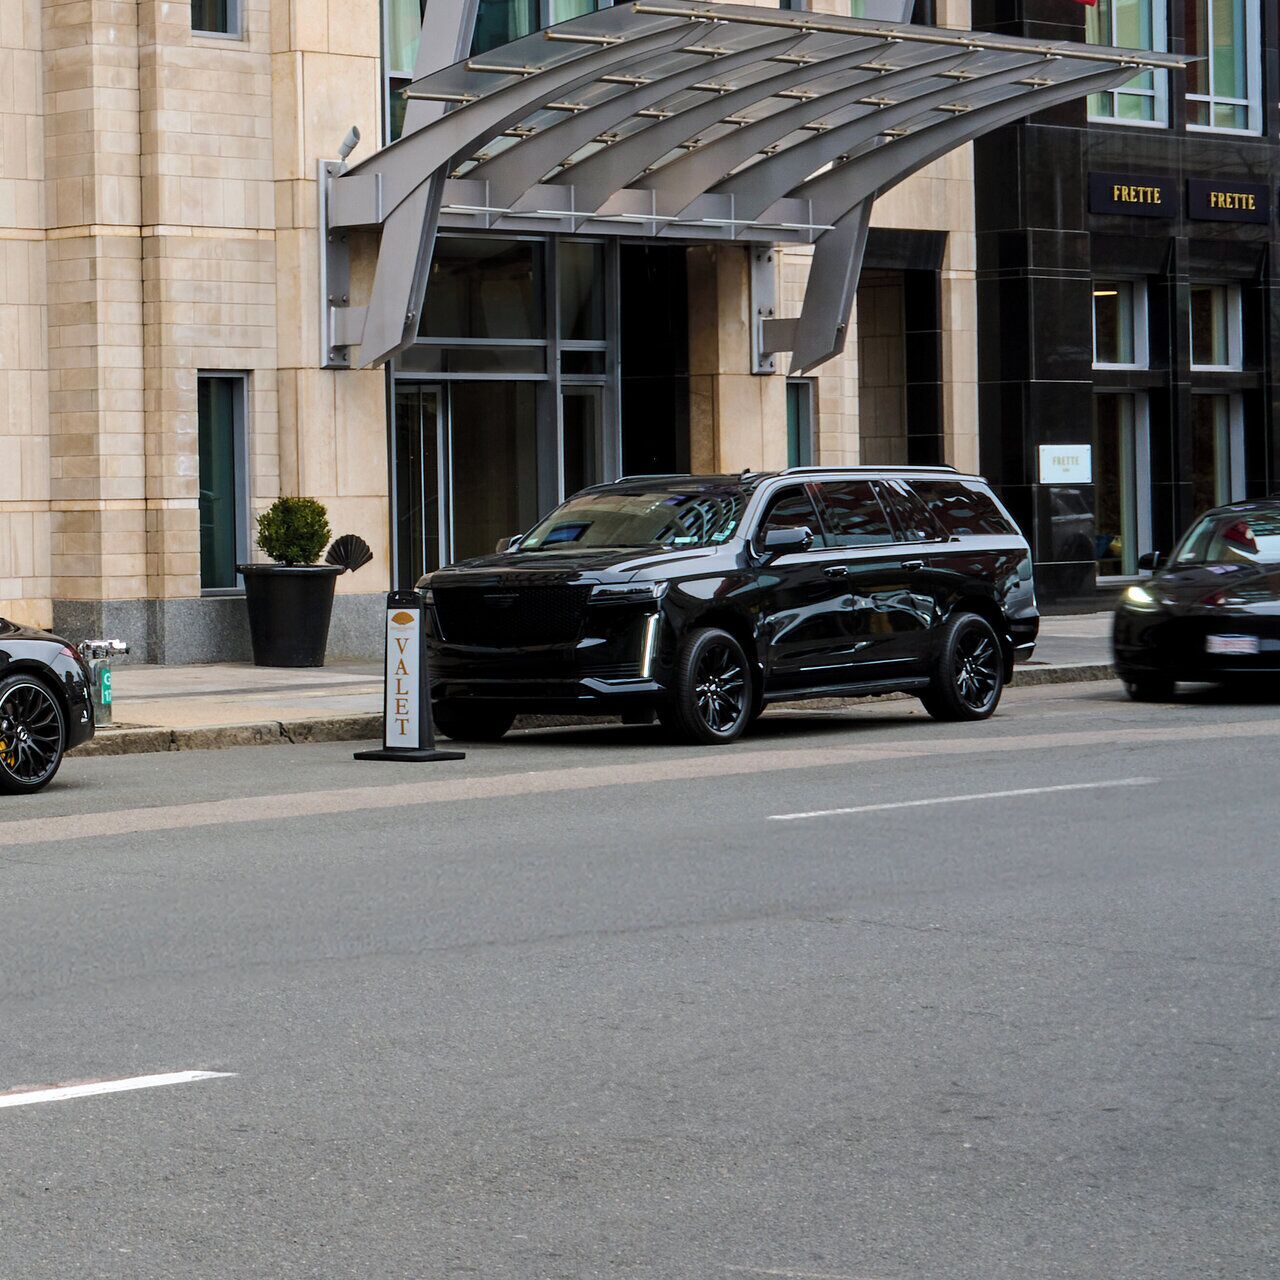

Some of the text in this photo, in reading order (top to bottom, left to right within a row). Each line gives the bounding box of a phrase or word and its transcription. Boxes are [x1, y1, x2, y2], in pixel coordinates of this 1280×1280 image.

[1113, 185, 1162, 204] FRETTE
[1210, 191, 1256, 210] FRETTE
[395, 637, 410, 736] VALET
